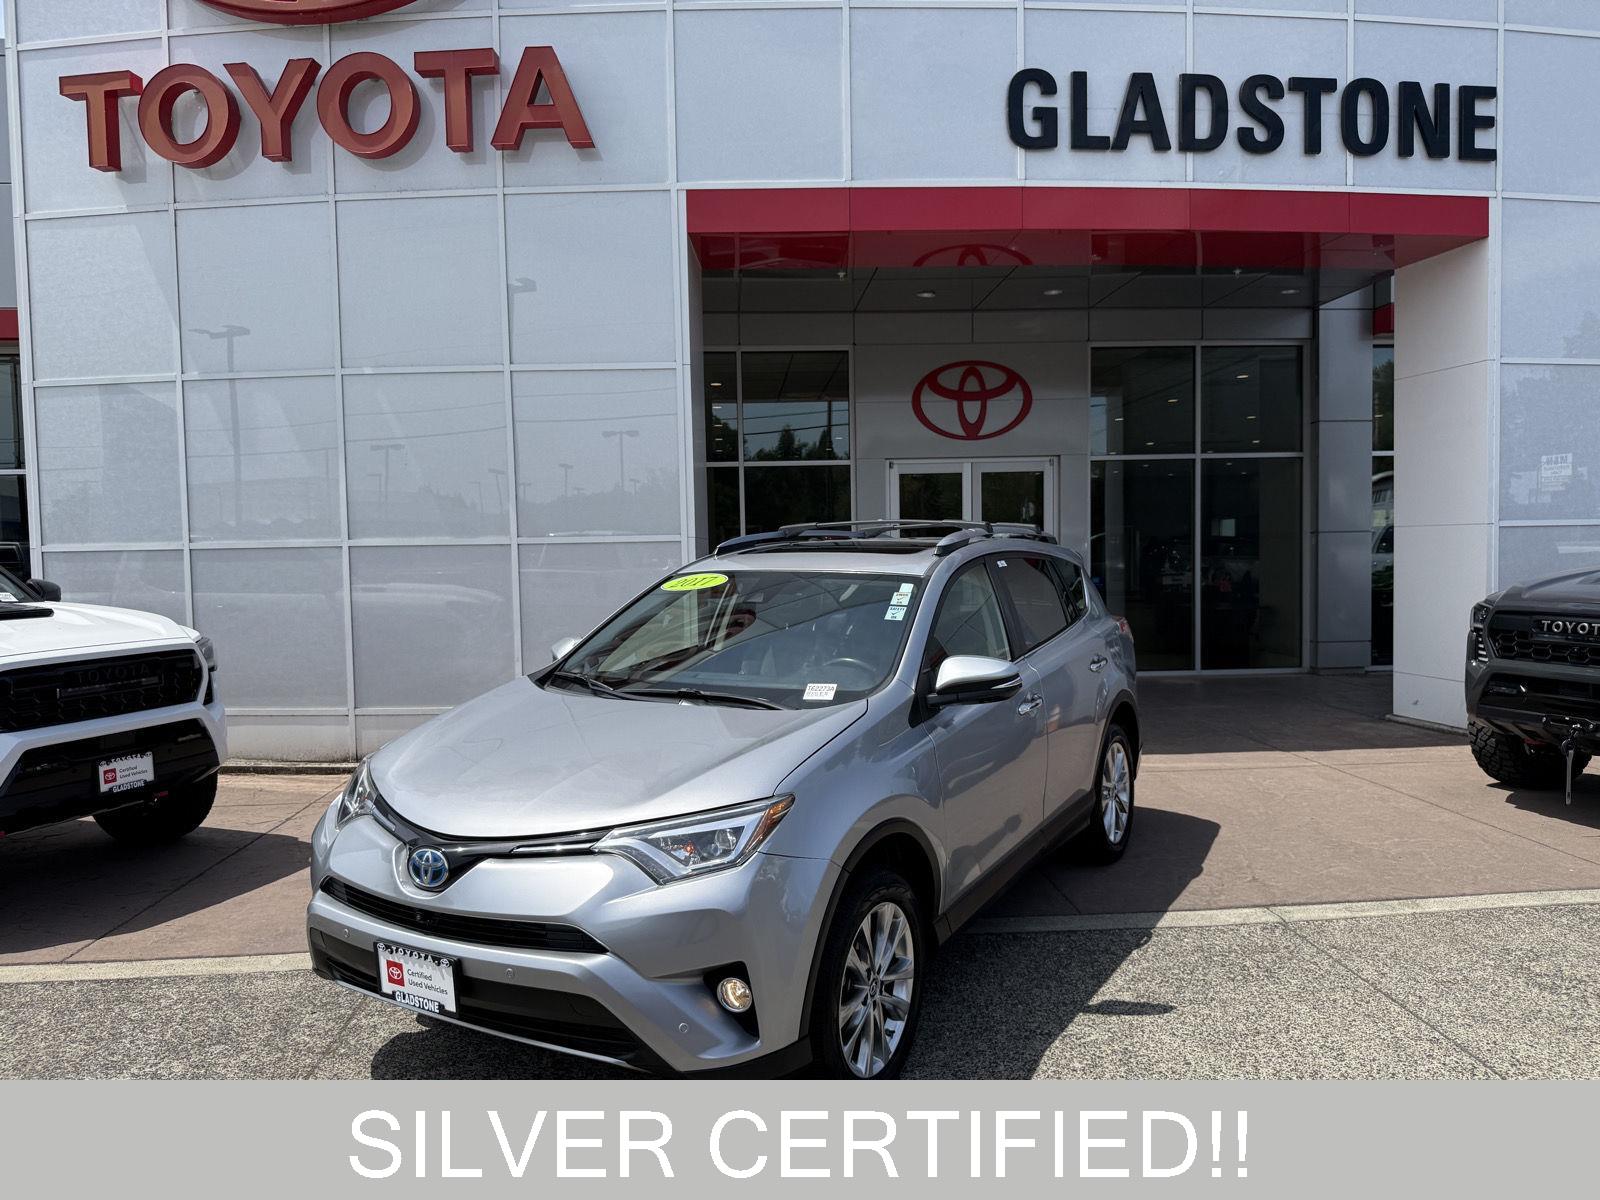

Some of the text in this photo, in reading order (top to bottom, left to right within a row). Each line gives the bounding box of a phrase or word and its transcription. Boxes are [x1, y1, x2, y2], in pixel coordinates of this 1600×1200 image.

[59, 46, 595, 172] TOYOTA
[1007, 68, 1498, 161] GLADSTONE
[77, 663, 150, 684] TOYOTA
[113, 780, 145, 793] GLADSTONE
[391, 946, 433, 963] TOYOTA
[407, 968, 432, 981] Certified
[408, 979, 448, 995] Used Vehicles
[395, 990, 440, 1013] GLADSTONE
